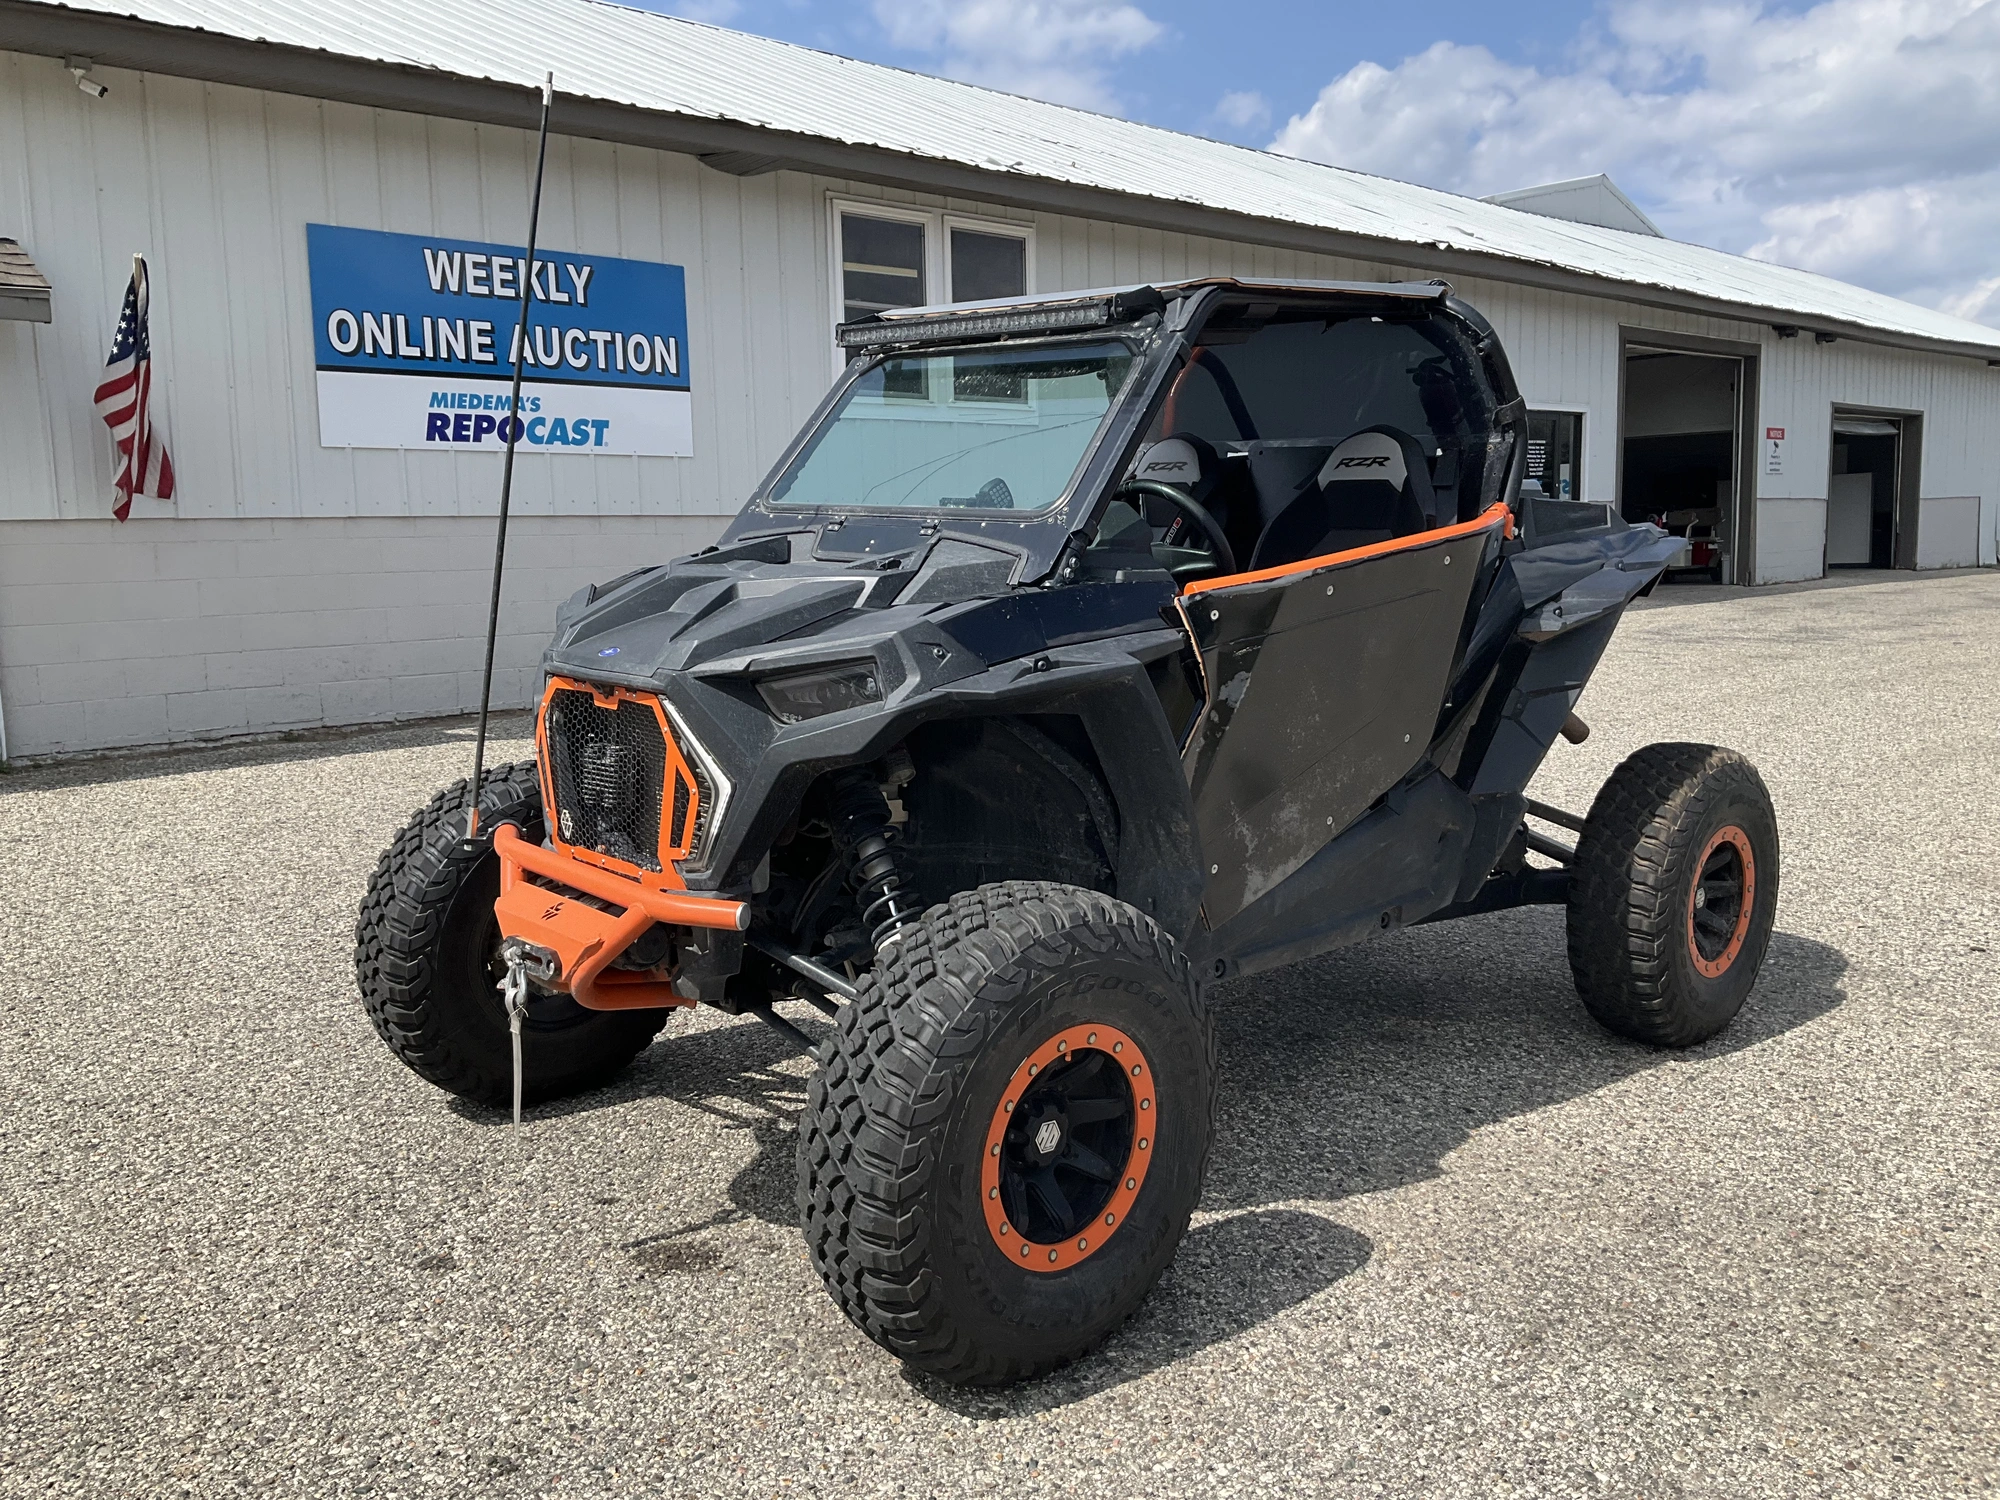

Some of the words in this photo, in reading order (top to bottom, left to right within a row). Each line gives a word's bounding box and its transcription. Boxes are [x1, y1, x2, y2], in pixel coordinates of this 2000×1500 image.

[423, 248, 593, 305] WEEKLY
[327, 309, 496, 363] ONLINE
[507, 323, 679, 375] AUCTION
[428, 391, 542, 412] MIEDEMA'S
[425, 412, 610, 447] REPOCAST
[1142, 461, 1188, 473] RZR
[1334, 456, 1391, 470] RZR
